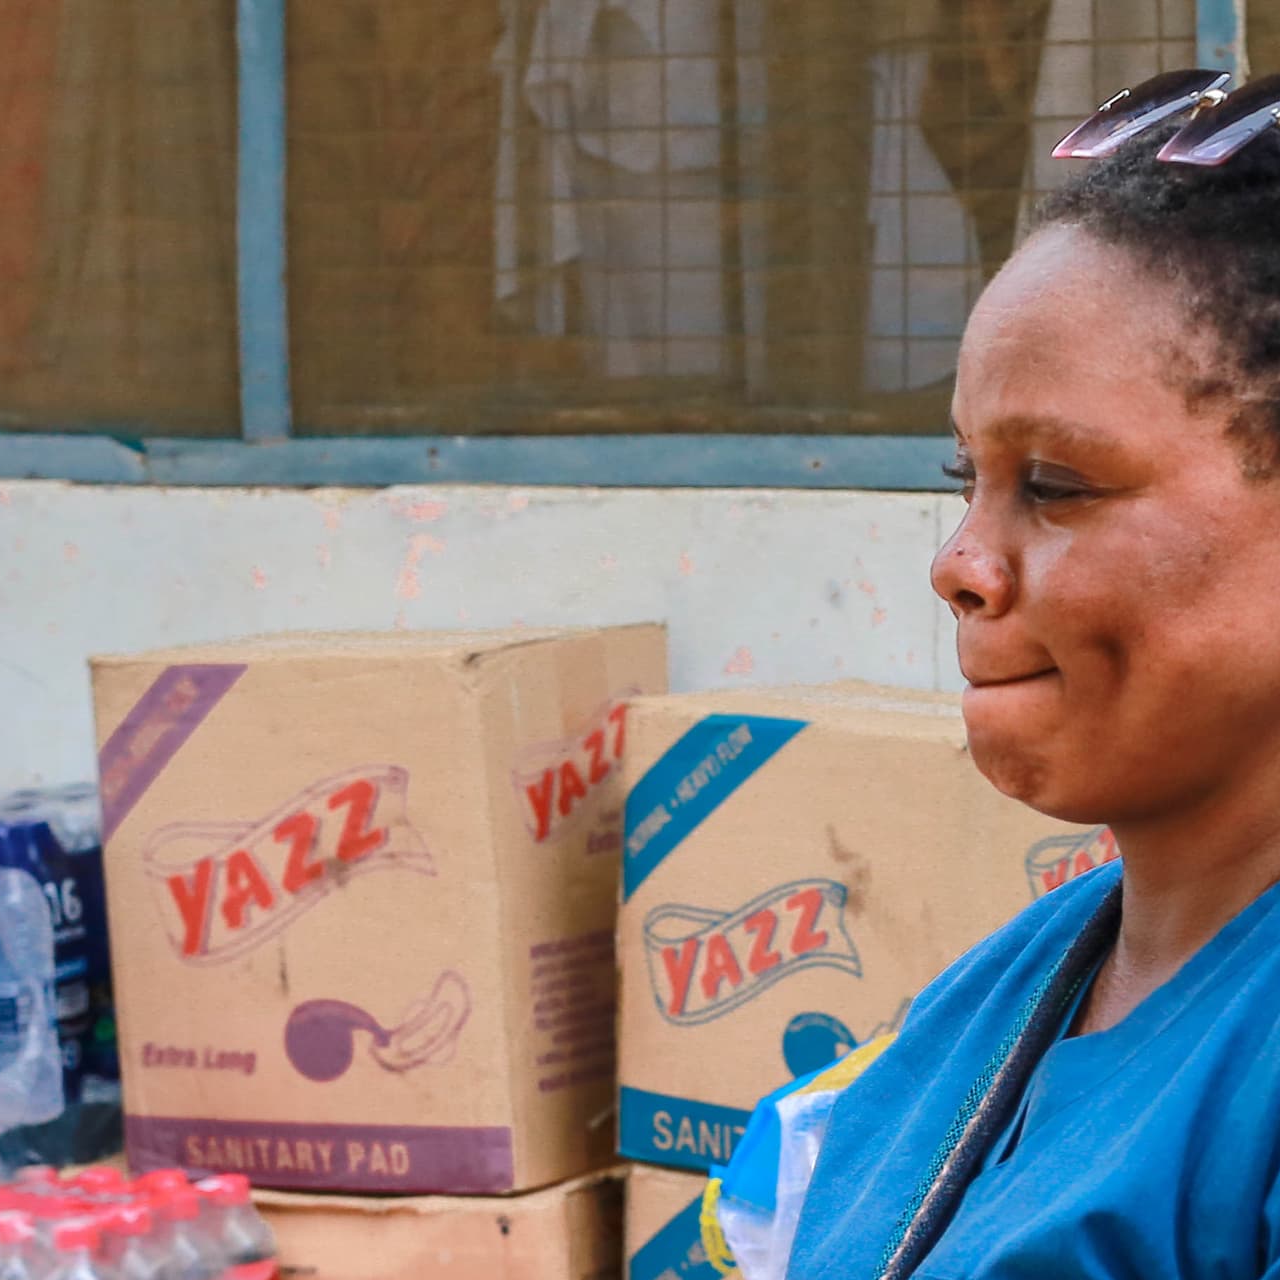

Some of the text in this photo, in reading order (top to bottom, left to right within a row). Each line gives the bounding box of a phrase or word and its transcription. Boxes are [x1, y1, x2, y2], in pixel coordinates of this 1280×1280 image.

[167, 778, 385, 956] YAZZ
[661, 888, 829, 1017] YAZZ
[141, 1042, 257, 1075] Extra Long
[185, 1135, 410, 1176] SANITARY PAD
